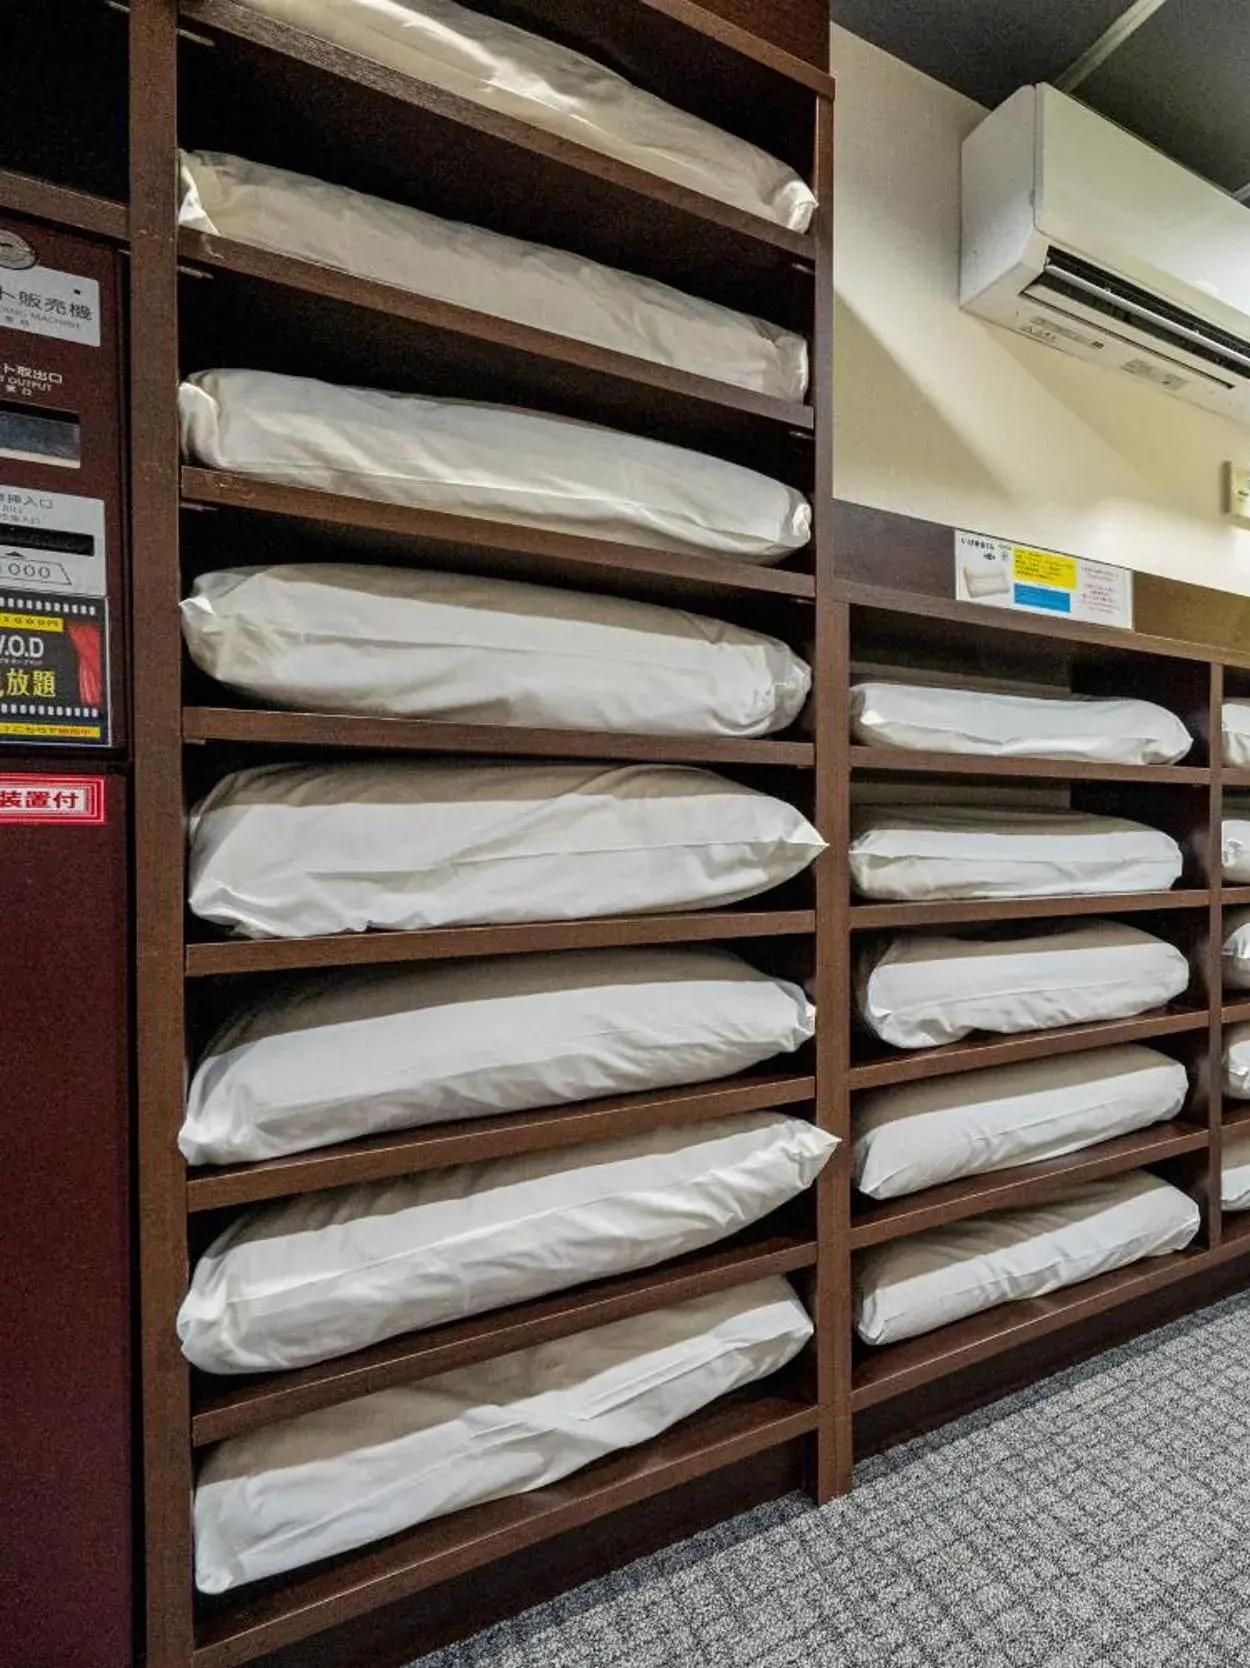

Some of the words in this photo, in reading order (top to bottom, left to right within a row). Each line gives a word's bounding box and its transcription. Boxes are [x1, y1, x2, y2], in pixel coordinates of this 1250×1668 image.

[0, 667, 56, 697] 放題
[0, 790, 79, 809] 装置付
